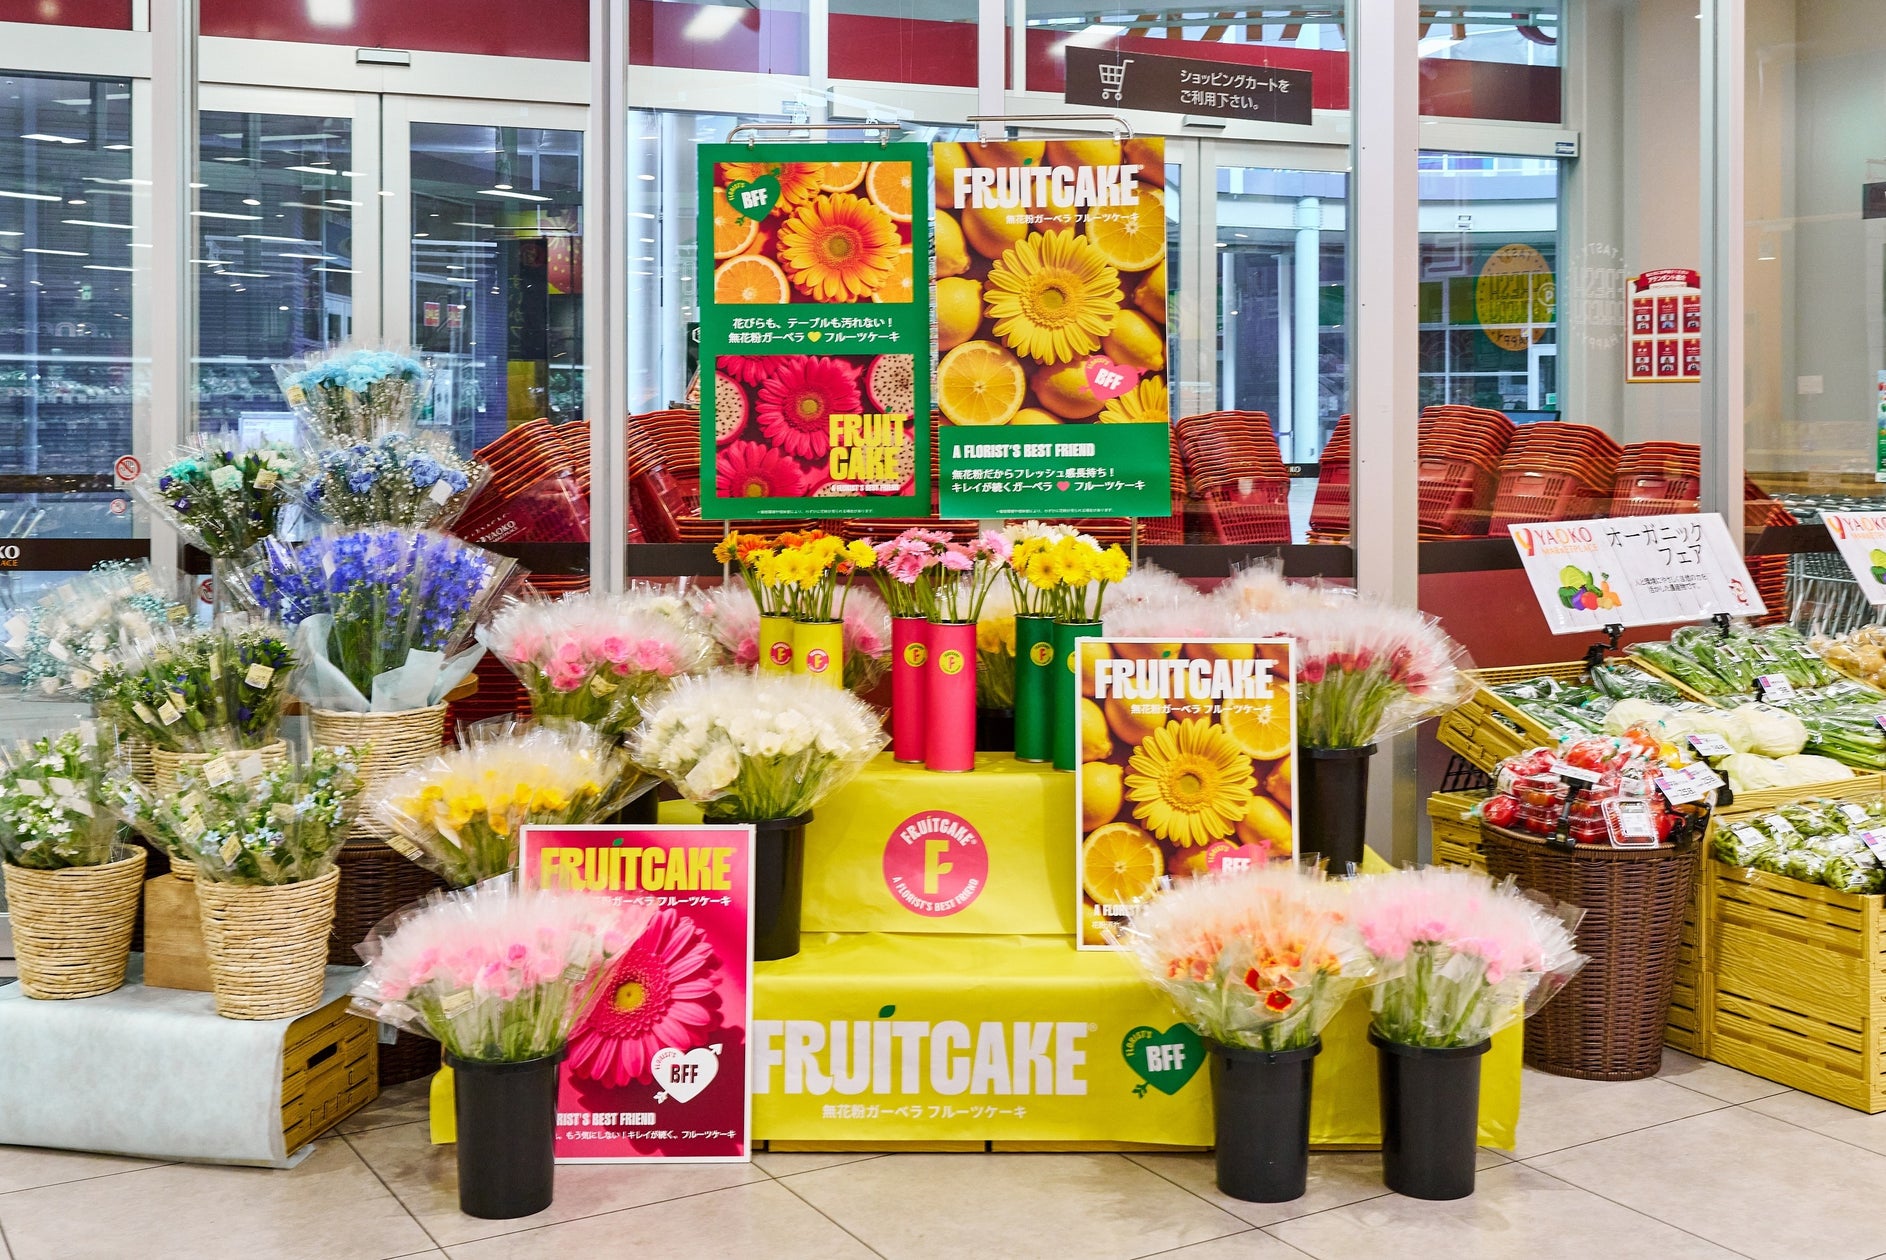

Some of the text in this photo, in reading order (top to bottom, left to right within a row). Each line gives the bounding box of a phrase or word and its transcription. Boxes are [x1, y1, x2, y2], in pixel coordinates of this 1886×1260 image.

[1180, 70, 1290, 93] ショッピングカートを
[1180, 90, 1260, 110] ご利用下さい。
[741, 187, 768, 209] BFF
[1075, 213, 1140, 223] フルーツケーキ
[728, 331, 900, 344] 無花粉ガーベラ フルーツケーキ
[1094, 368, 1124, 390] BFF
[829, 414, 907, 447] FRUIT
[952, 445, 961, 458] A
[1023, 444, 1053, 458] BEST
[1055, 443, 1095, 457] FRIEND
[829, 446, 900, 480] CAKE
[1074, 480, 1146, 492] フルーツケーキ
[1534, 526, 1592, 545] YAOKO
[1607, 522, 1701, 547] オーガニック
[1658, 544, 1701, 566] フェア
[1204, 704, 1273, 714] フルーツケーキ
[923, 839, 954, 895] F
[657, 895, 731, 907] フルーツケーキ
[892, 876, 904, 884] A
[934, 899, 956, 912] BEST
[955, 878, 979, 905] FRIEND
[752, 1020, 1087, 1096] FRUITCAKE
[1145, 1043, 1186, 1073] BFF
[669, 1064, 699, 1084] BFF
[557, 1112, 656, 1126] RIST'S BEST FRIEND
[822, 1105, 1027, 1119] 無花粉ガーベラ フルーツケーキ
